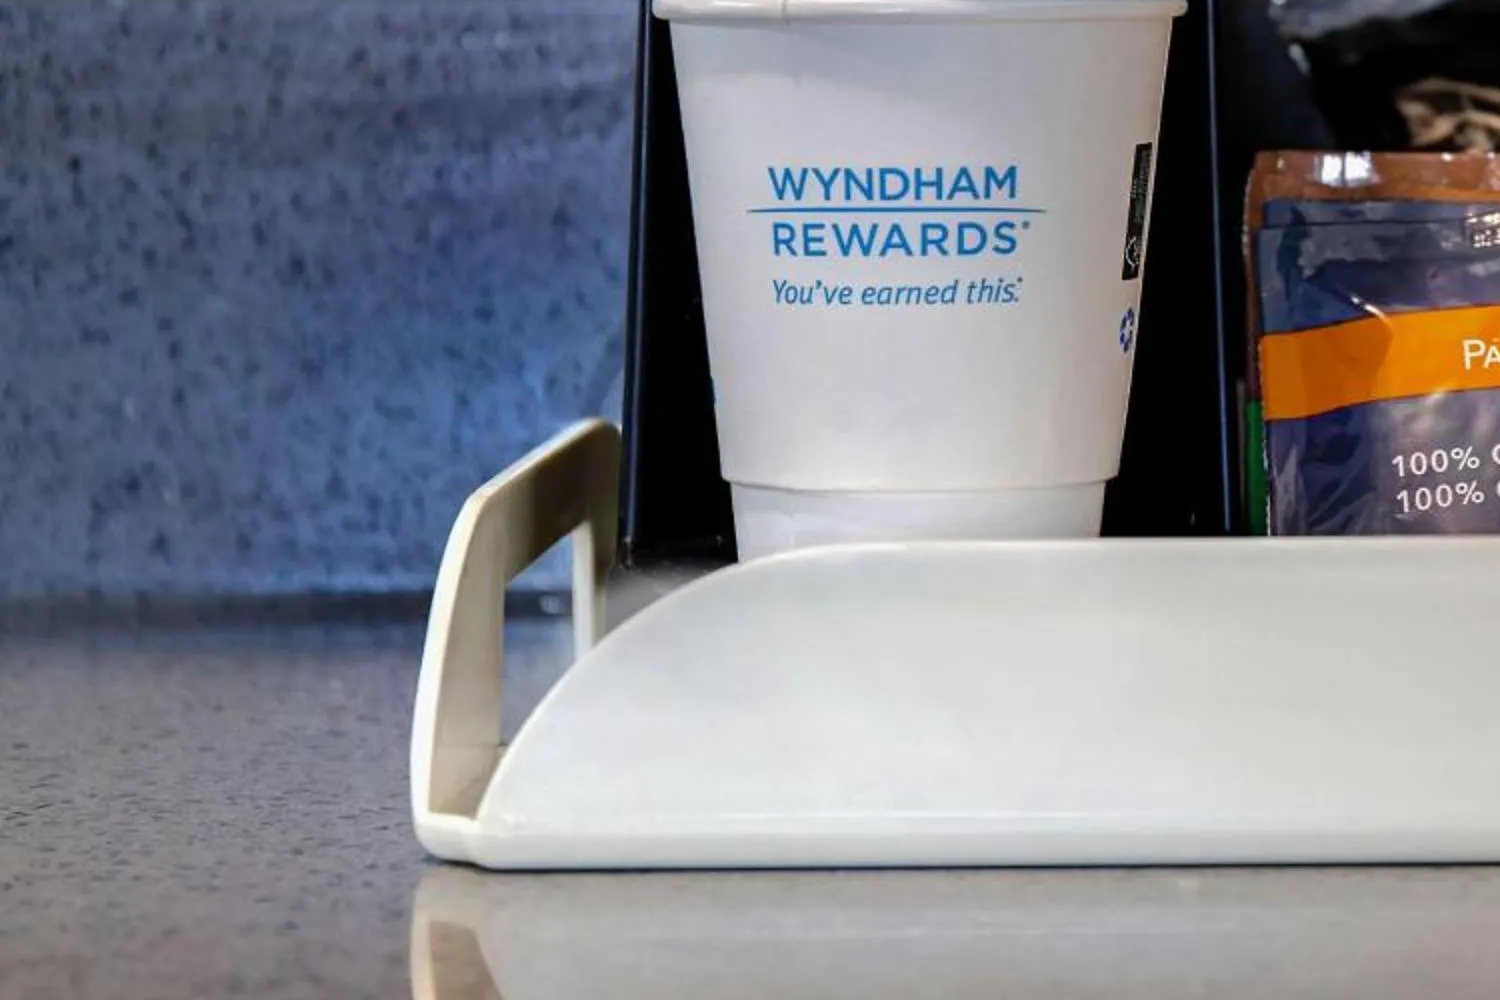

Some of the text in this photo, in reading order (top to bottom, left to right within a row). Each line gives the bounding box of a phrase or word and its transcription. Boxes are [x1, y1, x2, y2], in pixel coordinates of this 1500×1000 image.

[767, 165, 1018, 201] WYNDHAM
[771, 221, 1019, 257] REWARDS
[771, 279, 853, 305] You've
[860, 278, 959, 305] earned
[1391, 446, 1481, 477] 100%
[1396, 480, 1486, 513] 100%
